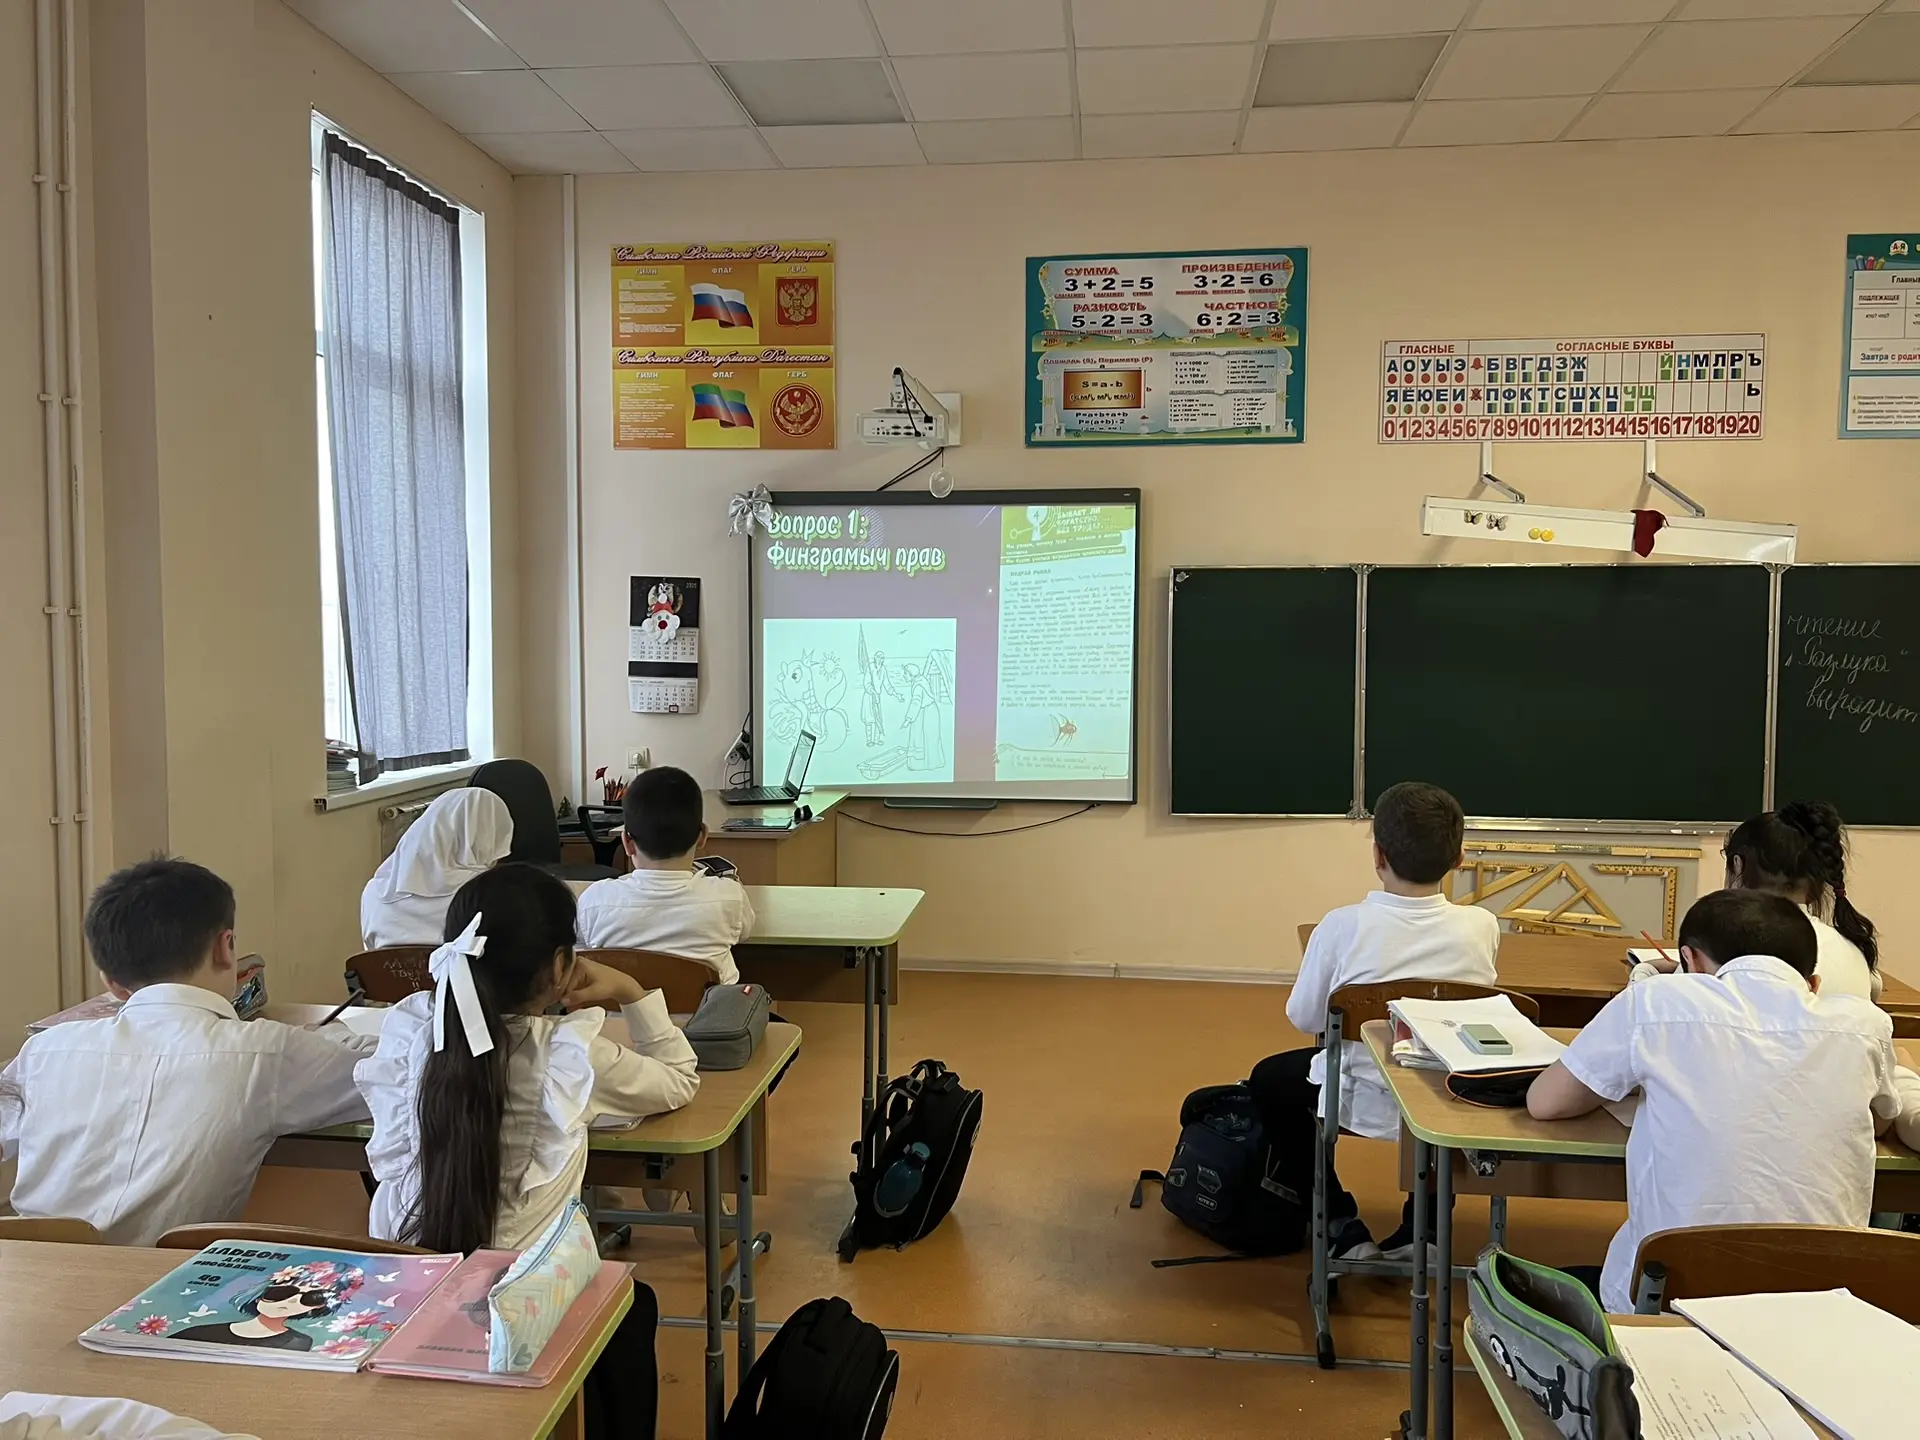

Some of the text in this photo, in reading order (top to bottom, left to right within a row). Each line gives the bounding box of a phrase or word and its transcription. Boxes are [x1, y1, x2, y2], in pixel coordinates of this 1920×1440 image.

[615, 245, 681, 261] Символика
[682, 244, 754, 260] Российской
[1064, 267, 1120, 277] СУММА
[1181, 262, 1291, 273] ПРОИЗВЕДЕНИЕ
[1064, 278, 1079, 292] 3
[1101, 277, 1116, 291] 2
[1139, 276, 1154, 290] 5
[1193, 274, 1208, 288] 3
[1220, 274, 1236, 288] 2
[1259, 273, 1274, 287] 6
[1073, 302, 1147, 312] РАЗНОСТЬ
[1204, 301, 1279, 311] ЧАСТНОЕ
[1071, 315, 1086, 328] 5
[1101, 314, 1116, 327] 2
[1139, 313, 1154, 327] 3
[1196, 313, 1211, 326] 6
[1227, 312, 1242, 326] 2
[1266, 311, 1281, 325] 3
[1399, 344, 1455, 354] ГЛАСНЫЕ
[1556, 340, 1674, 352] СОГЛАСНЫЕ БУКВЫ
[617, 348, 831, 368] Символика Республики Дагестан
[1387, 352, 1762, 372] А О У Ы Э Б В Г Д З Ж Й Н М Л Р Ъ
[1860, 353, 1889, 362] Завтра
[1386, 383, 1760, 402] Я Ё Ю Е И П Ф К Т С Ш Х Ц Ч Щ Ь
[1384, 414, 1760, 438] 0 1 2 3 4 5 6 7 8 9 10 11 12 13 14 15 16 17 18 19 20
[767, 541, 944, 576] Финграмыч прав
[202, 1247, 291, 1261] АЛЬБОМ
